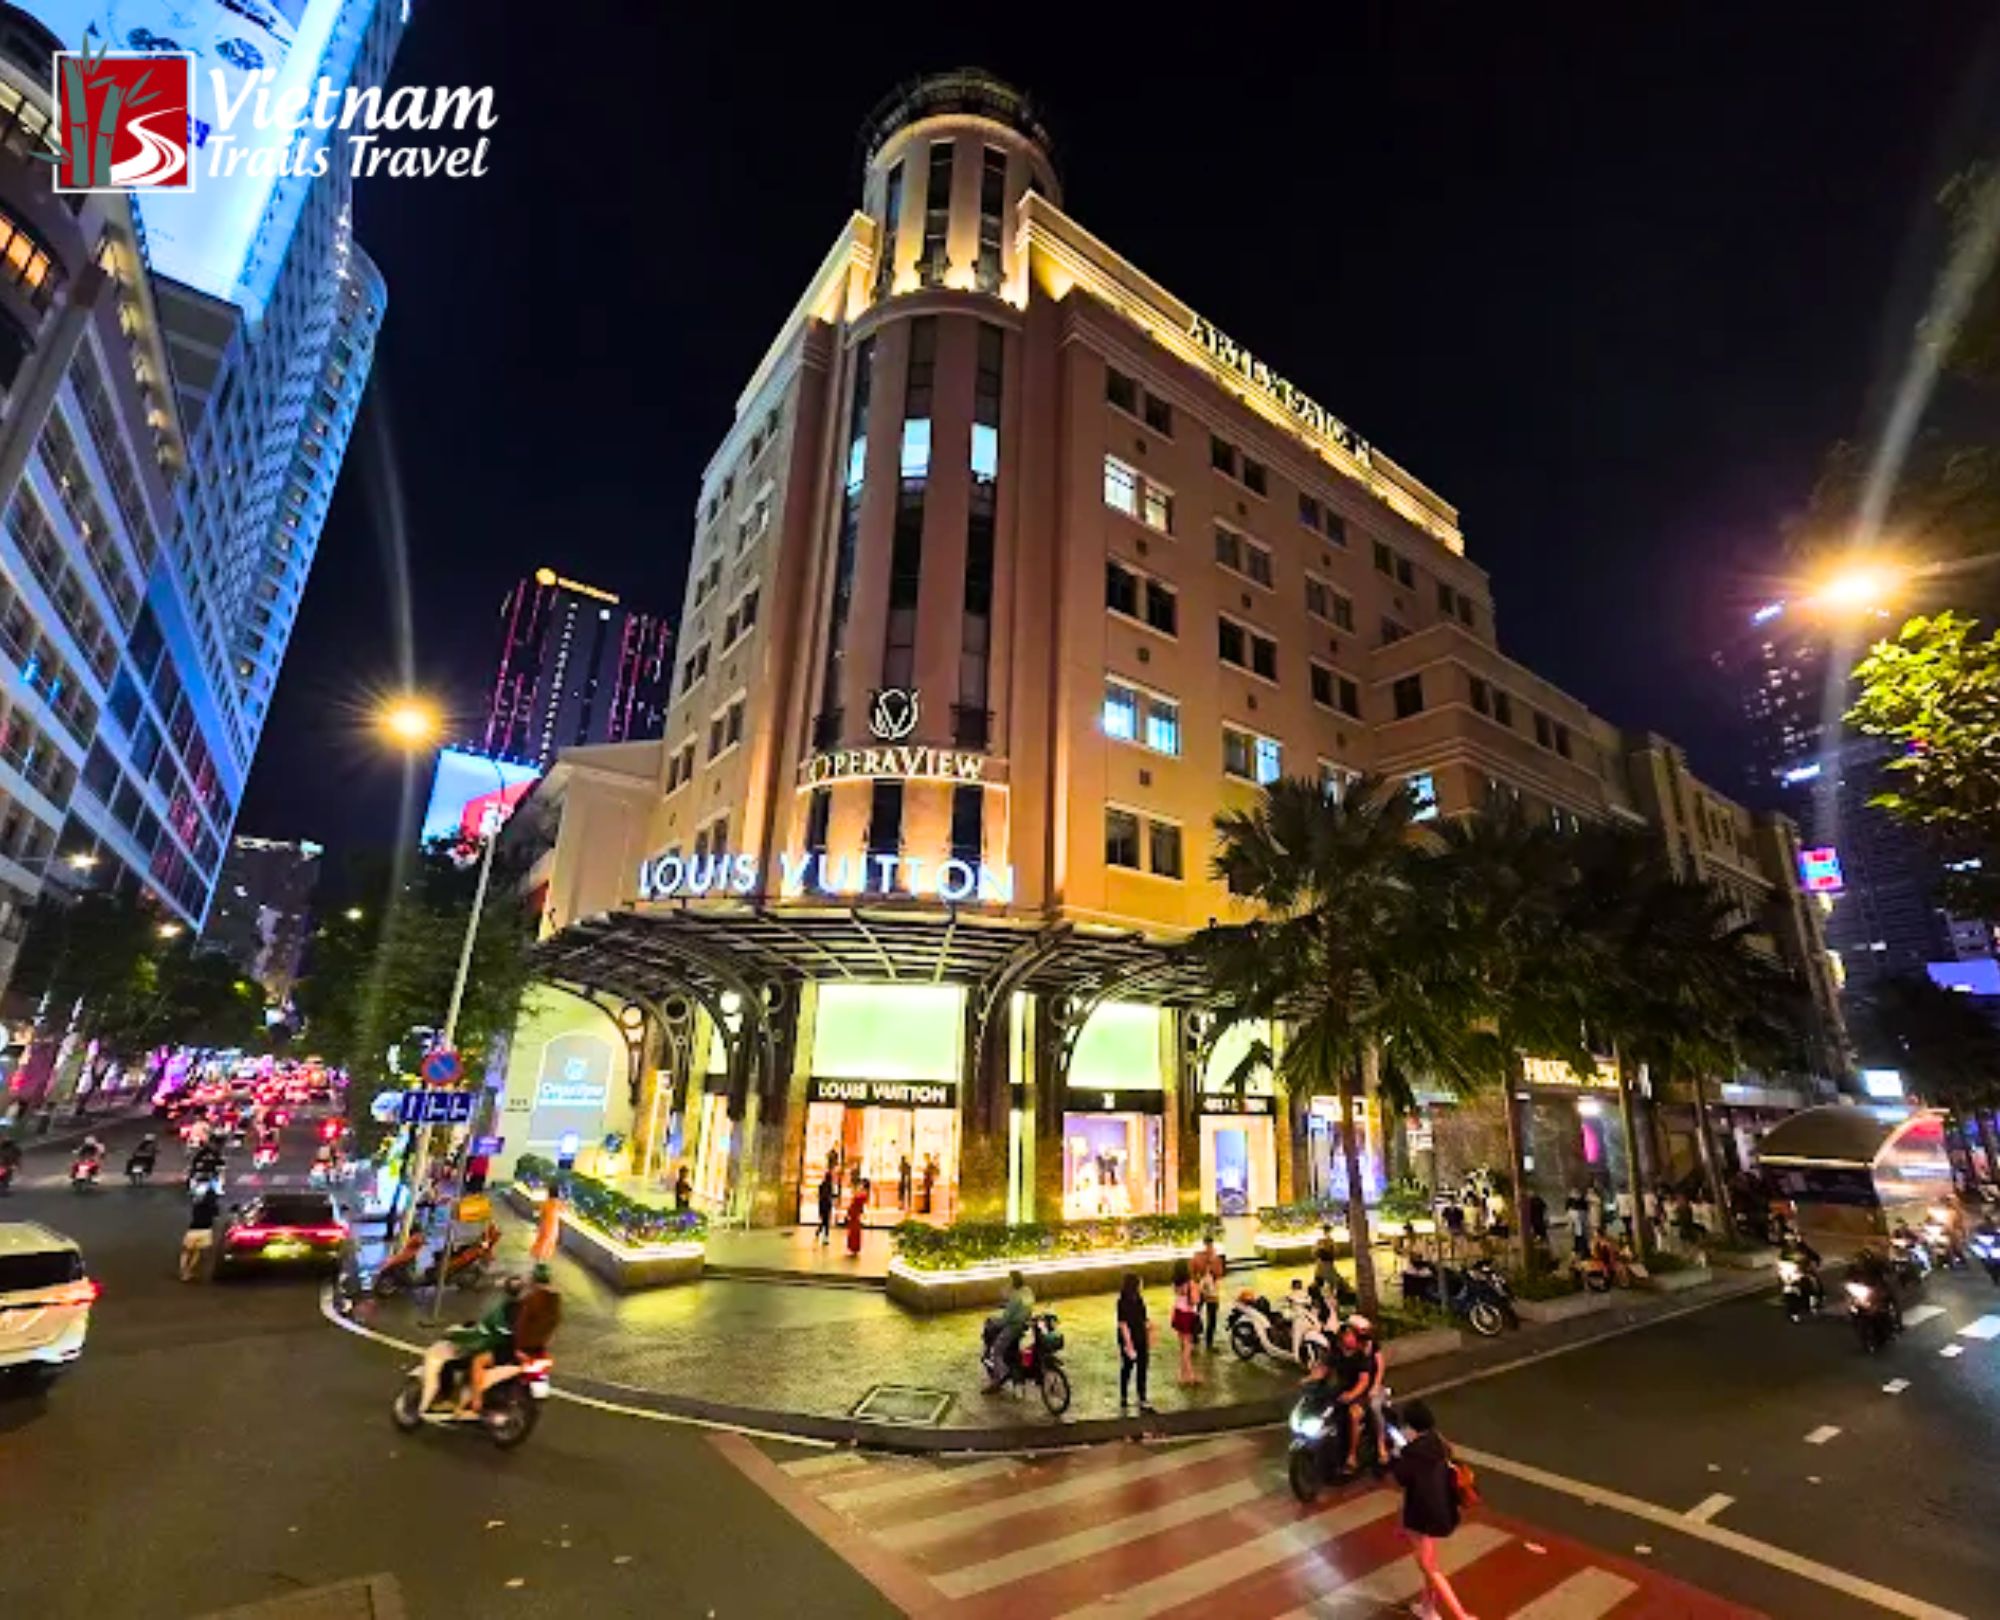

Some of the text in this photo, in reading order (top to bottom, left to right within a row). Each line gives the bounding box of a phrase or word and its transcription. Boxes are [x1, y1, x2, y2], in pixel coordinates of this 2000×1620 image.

[638, 851, 1015, 903] LOUIS VUITTON
[817, 1082, 947, 1103] LOUIS VUITTON
